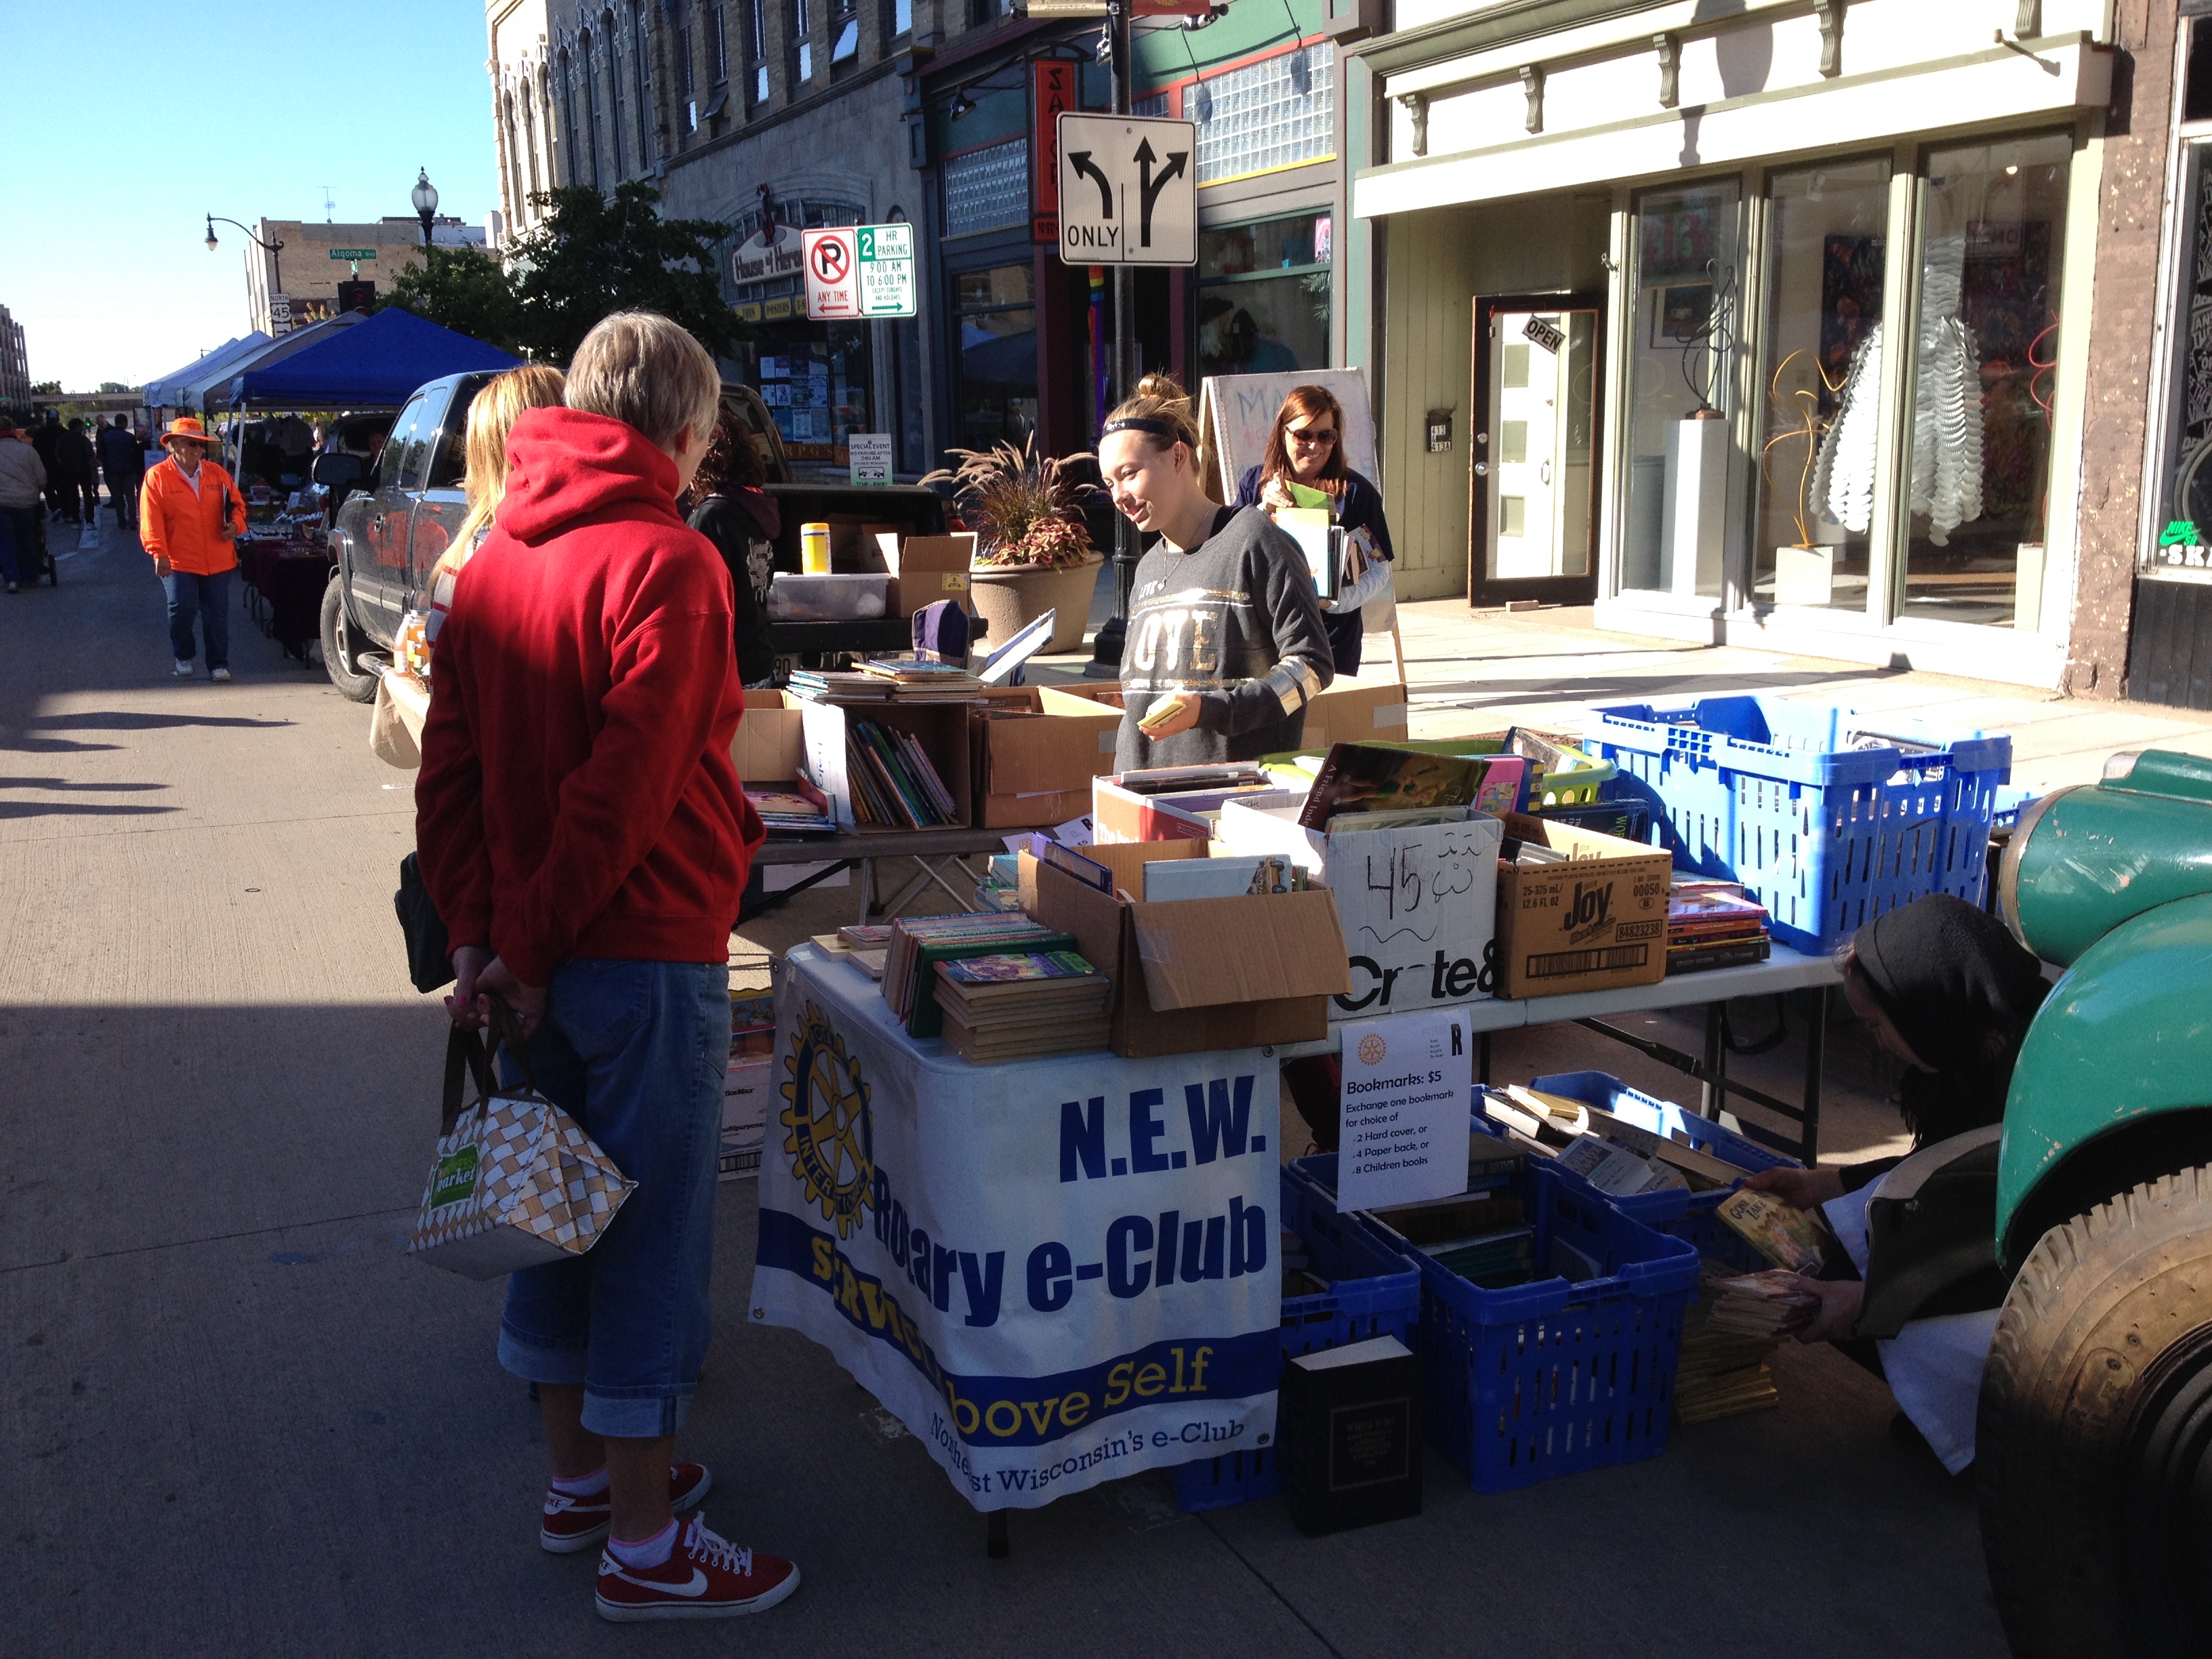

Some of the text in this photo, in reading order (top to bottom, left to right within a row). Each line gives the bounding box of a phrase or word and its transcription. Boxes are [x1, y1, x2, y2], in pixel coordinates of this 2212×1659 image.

[886, 230, 897, 241] HR
[1068, 225, 1119, 247] ONLY
[861, 233, 873, 256] 2
[878, 244, 907, 256] PARKING
[735, 253, 764, 280] House
[870, 262, 901, 273] 9:00 AM
[867, 274, 907, 286] TO 6:00 PM
[818, 291, 848, 302] ANY TIME
[273, 308, 290, 318] 45
[1526, 319, 1565, 352] OPEN
[1431, 425, 1445, 434] 413
[1431, 442, 1451, 451] 413A
[2167, 521, 2194, 534] NIKE
[2184, 535, 2198, 546] SB
[1312, 775, 1334, 804] Friend
[1368, 844, 1422, 920] 45
[1523, 884, 1547, 896] 25-375
[1633, 882, 1660, 897] 00050
[1523, 897, 1559, 909] 12.6 FL OZ
[1563, 882, 1614, 931] Joy
[1333, 939, 1495, 1011] Crte&
[1451, 1024, 1462, 1056] R
[1347, 1070, 1441, 1094] Bookmarks: $5
[1346, 1090, 1454, 1113] Exchange one bookmark
[1346, 1112, 1399, 1128] for choice of
[1060, 1076, 1266, 1183] N.E.W.
[1365, 1130, 1388, 1141] Hard
[1391, 1128, 1416, 1137] cover,
[1365, 1147, 1391, 1157] Paper
[1394, 1142, 1418, 1152] back,
[1364, 1161, 1400, 1173] Children
[1403, 1156, 1428, 1167] books
[1746, 1200, 1767, 1220] LAKE
[874, 1165, 1267, 1328] Rotary e-Club
[942, 1376, 1090, 1437] bove
[1104, 1347, 1214, 1409] Self
[997, 1431, 1144, 1492] Wisconsin's
[1152, 1419, 1244, 1449] e-Club
